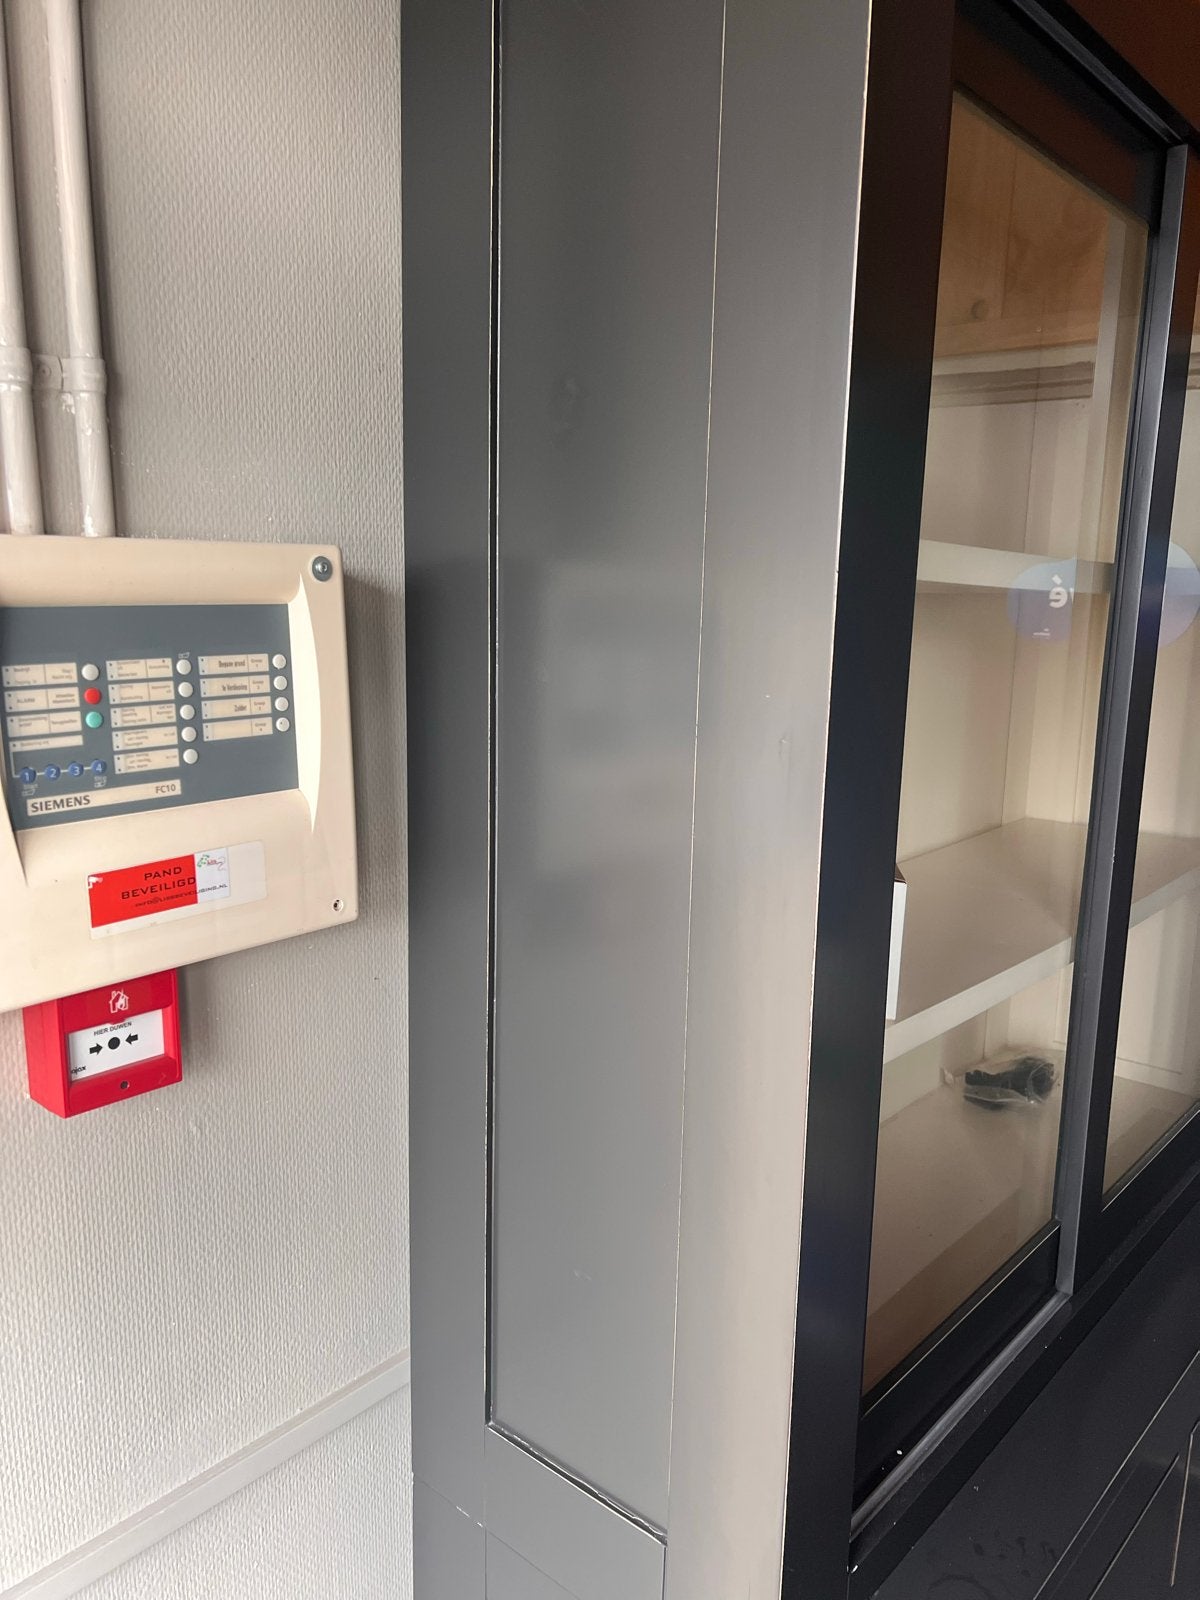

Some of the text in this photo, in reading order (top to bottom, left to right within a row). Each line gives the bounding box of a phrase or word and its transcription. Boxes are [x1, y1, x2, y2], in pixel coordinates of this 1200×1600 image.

[50, 769, 57, 778] 2
[73, 767, 80, 776] 3
[95, 764, 102, 773] 4
[24, 772, 30, 781] 1
[155, 783, 177, 795] FC10
[31, 795, 91, 813] SIEMENS
[144, 866, 183, 881] PAND
[121, 877, 197, 900] BEVEILIGD
[94, 1021, 132, 1036] HIER DUWEN
